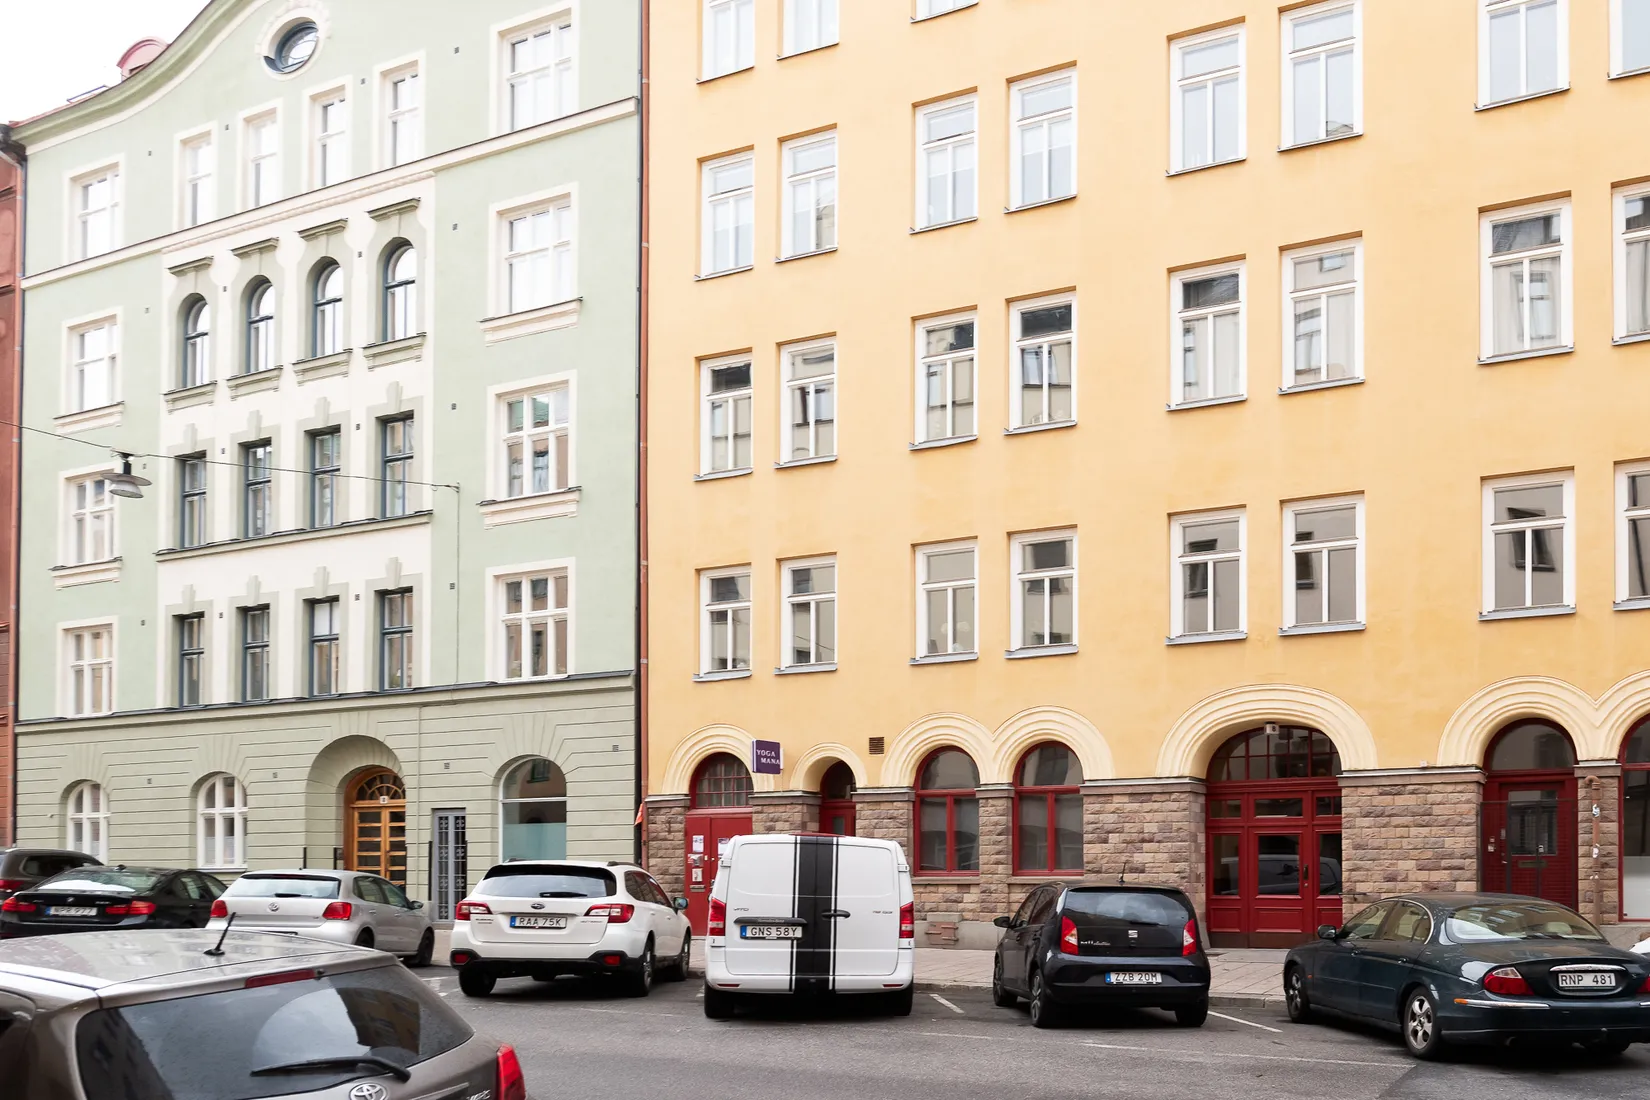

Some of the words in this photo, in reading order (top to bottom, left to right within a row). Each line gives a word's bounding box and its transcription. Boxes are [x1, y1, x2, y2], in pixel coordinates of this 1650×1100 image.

[756, 749, 776, 757] YOGA
[760, 757, 780, 765] MANA
[519, 917, 539, 926] RAA
[542, 918, 562, 926] 75K
[750, 927, 772, 936] GNS
[775, 927, 798, 936] 58Y
[1114, 972, 1135, 981] ZZB
[1137, 972, 1157, 981] 20M
[1560, 974, 1584, 985] RNP
[1592, 974, 1613, 985] 481
